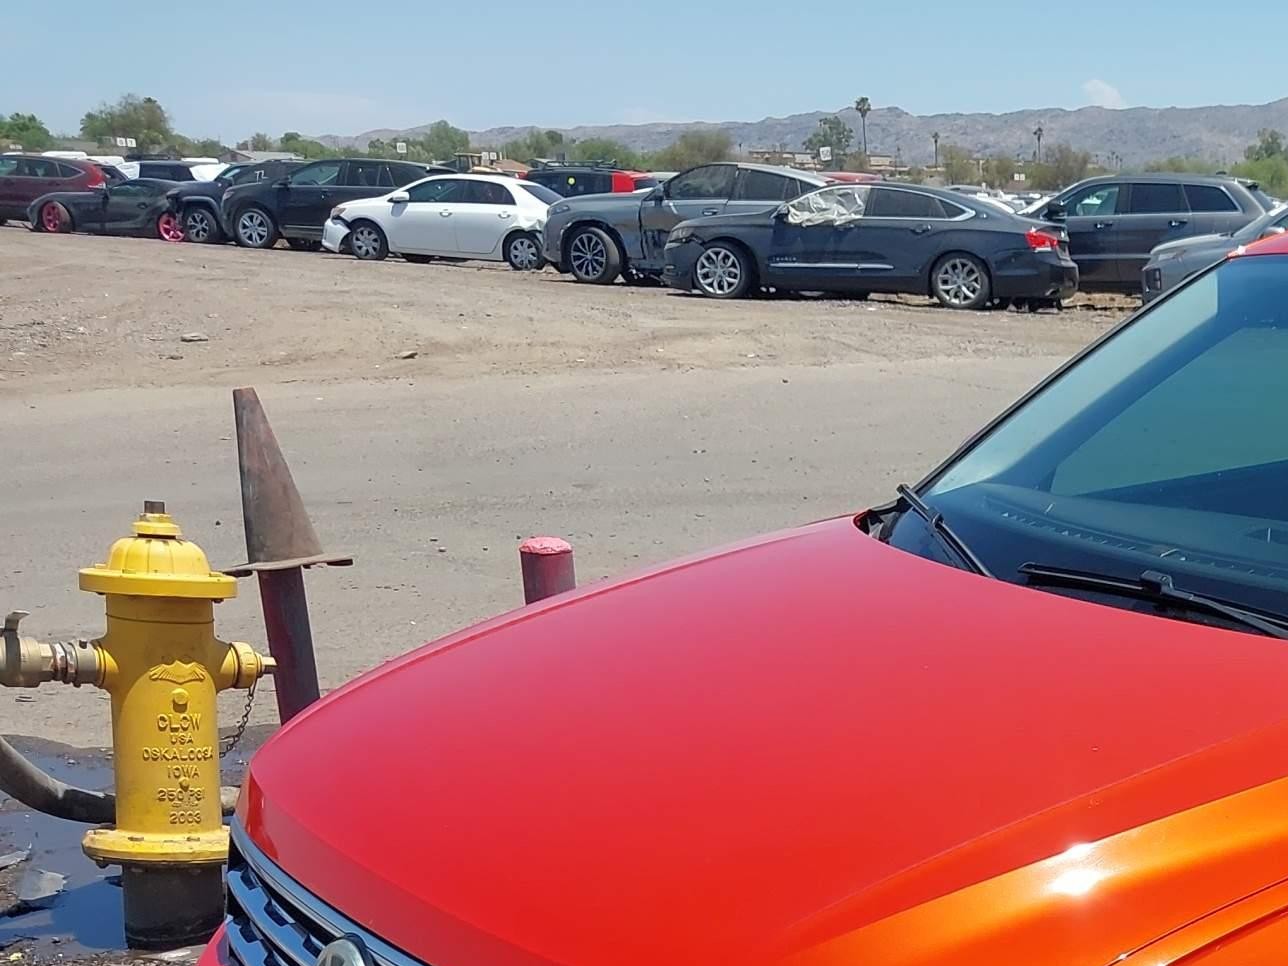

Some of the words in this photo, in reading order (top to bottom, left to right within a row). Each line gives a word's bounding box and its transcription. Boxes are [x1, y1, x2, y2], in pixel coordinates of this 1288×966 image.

[157, 713, 201, 732] CLOW
[170, 732, 194, 745] USA
[167, 764, 200, 779] IOWA
[169, 811, 202, 825] 2003
